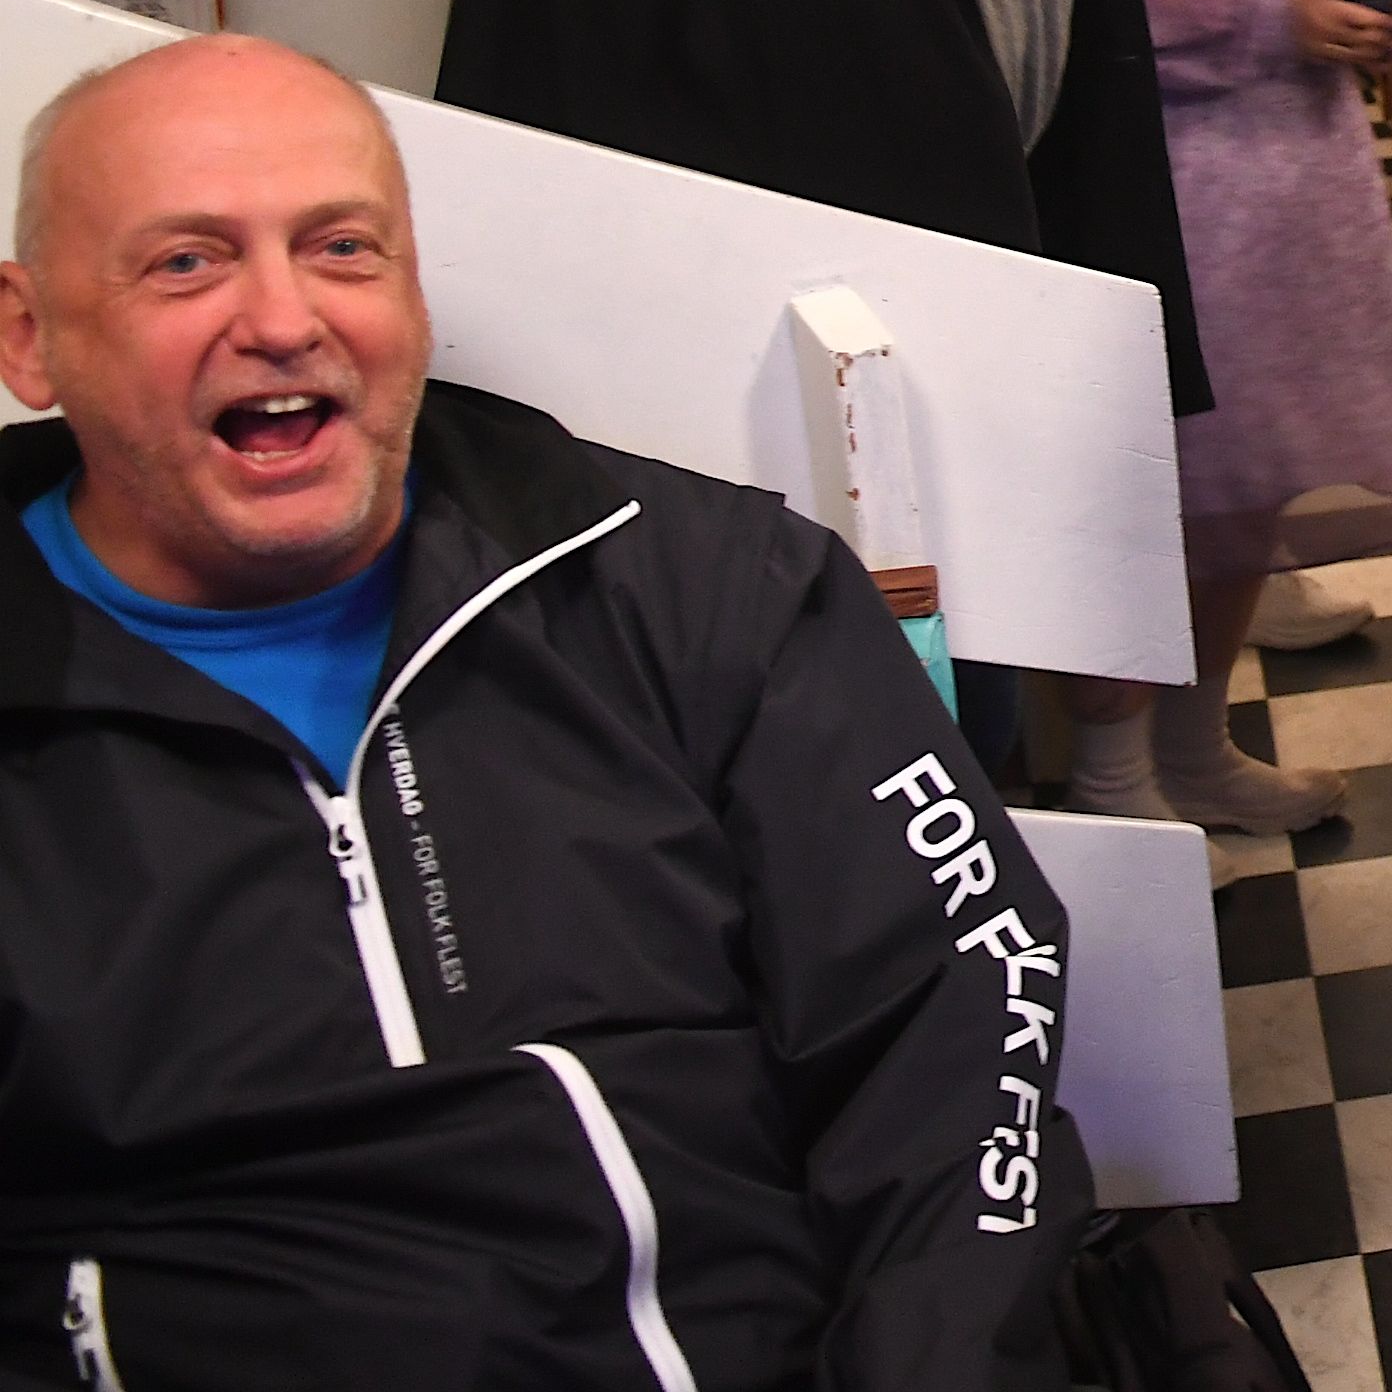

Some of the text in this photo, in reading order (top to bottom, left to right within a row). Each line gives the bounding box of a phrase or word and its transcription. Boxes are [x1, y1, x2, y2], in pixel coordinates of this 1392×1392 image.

[383, 721, 424, 816] HVERDAG
[411, 835, 439, 875] FOR
[421, 878, 452, 932] FOLK
[870, 752, 997, 918] FOR
[954, 907, 1061, 1065] FLK
[435, 933, 468, 994] FLEST
